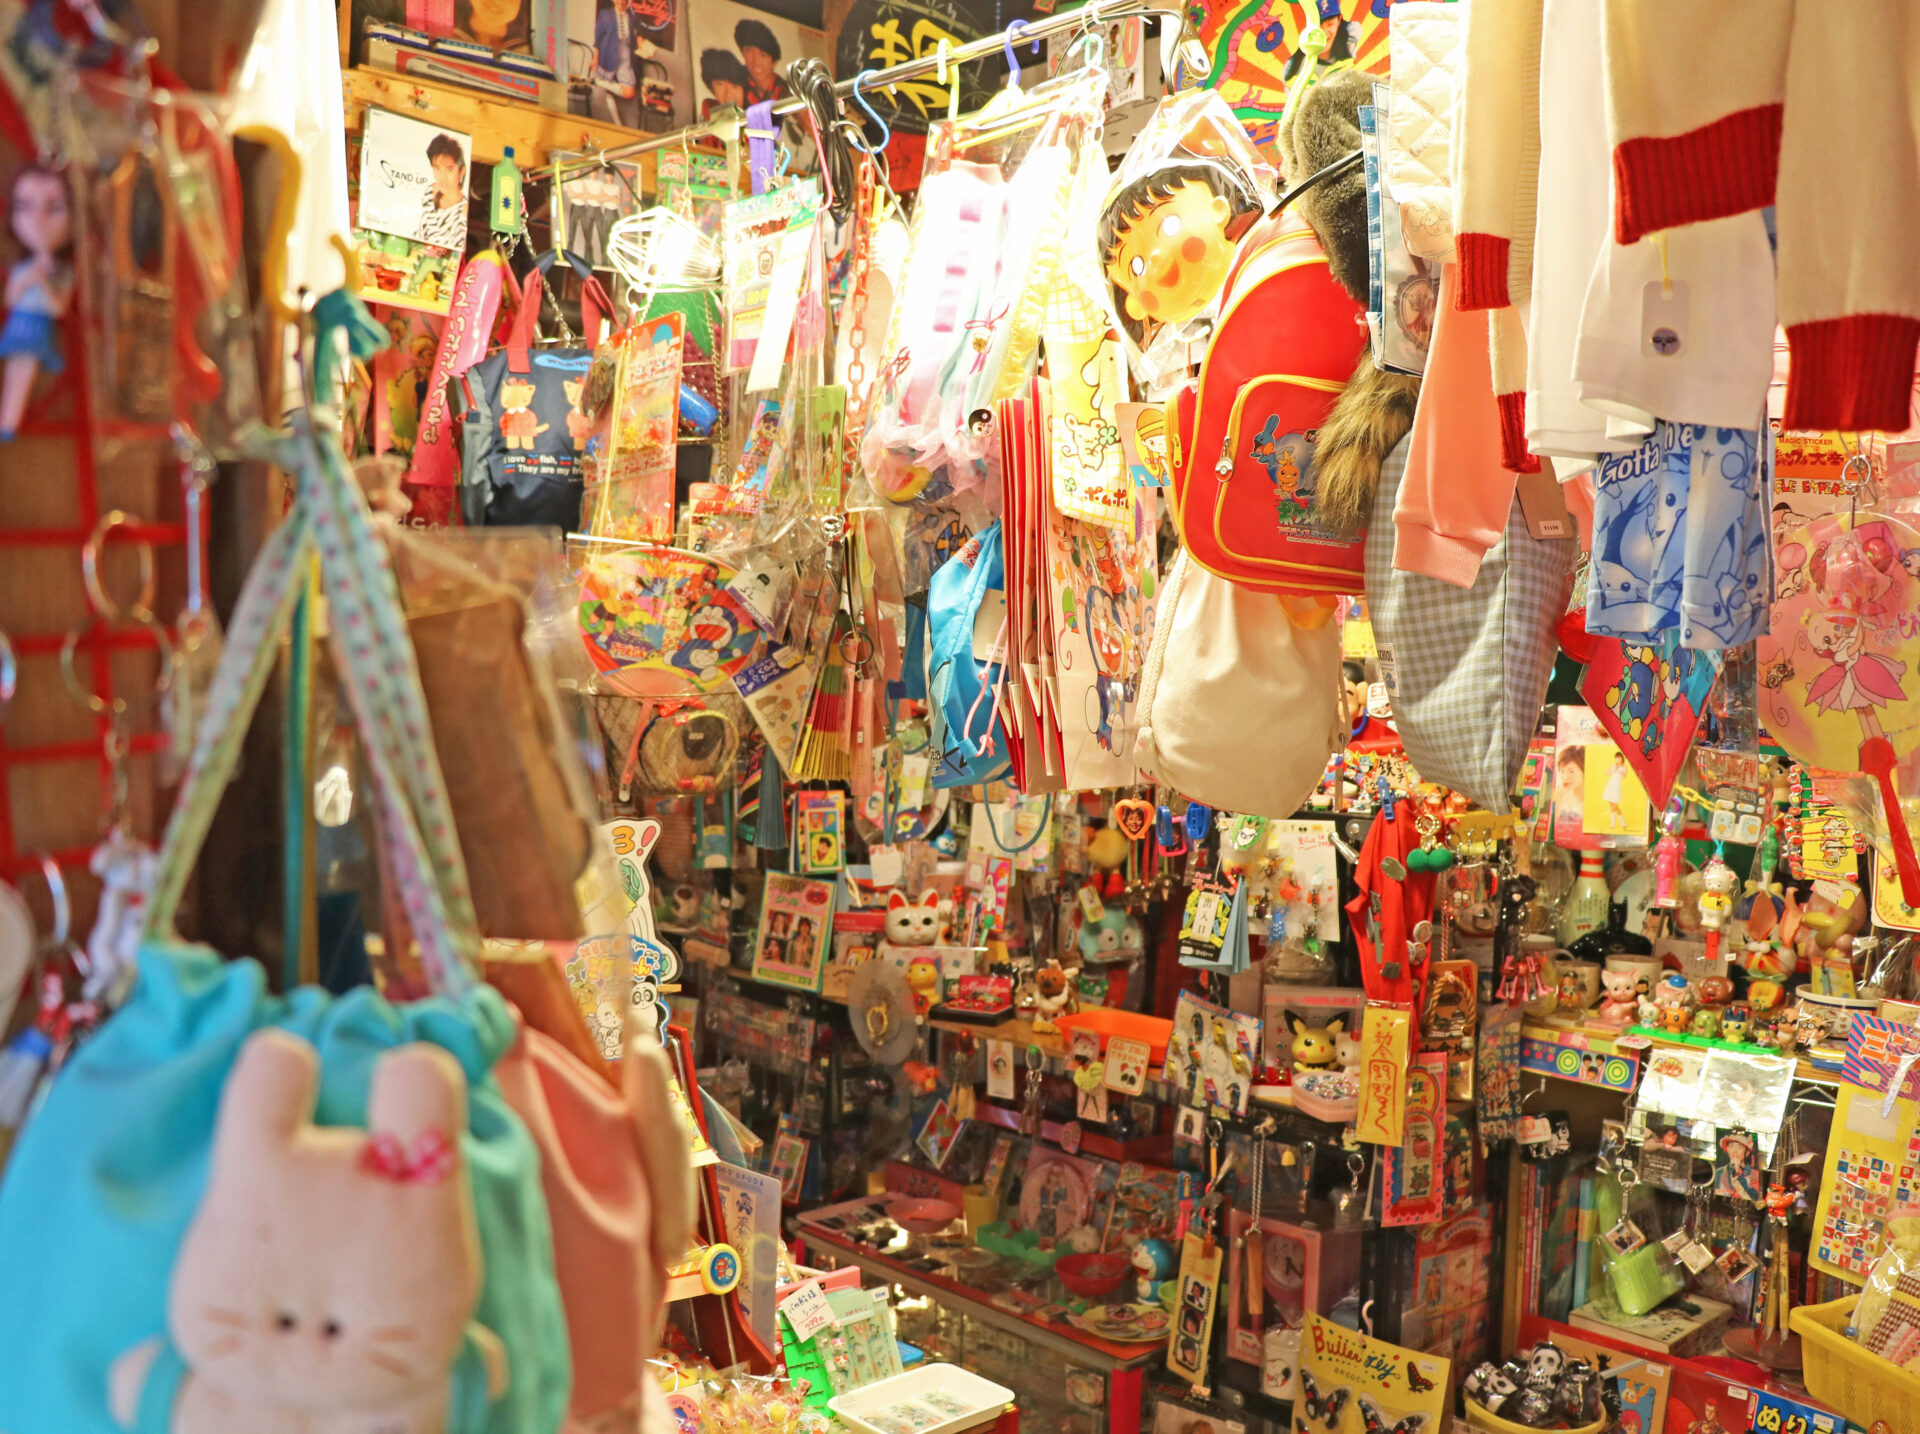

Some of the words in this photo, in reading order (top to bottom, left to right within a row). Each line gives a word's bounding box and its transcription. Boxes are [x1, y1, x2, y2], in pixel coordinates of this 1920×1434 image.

[380, 160, 414, 189] STAND
[415, 176, 428, 185] UP
[517, 463, 539, 475] They
[541, 466, 556, 475] are
[556, 467, 570, 476] my
[1597, 441, 1661, 488] Gotta
[1333, 1367, 1368, 1386] BROOCH
